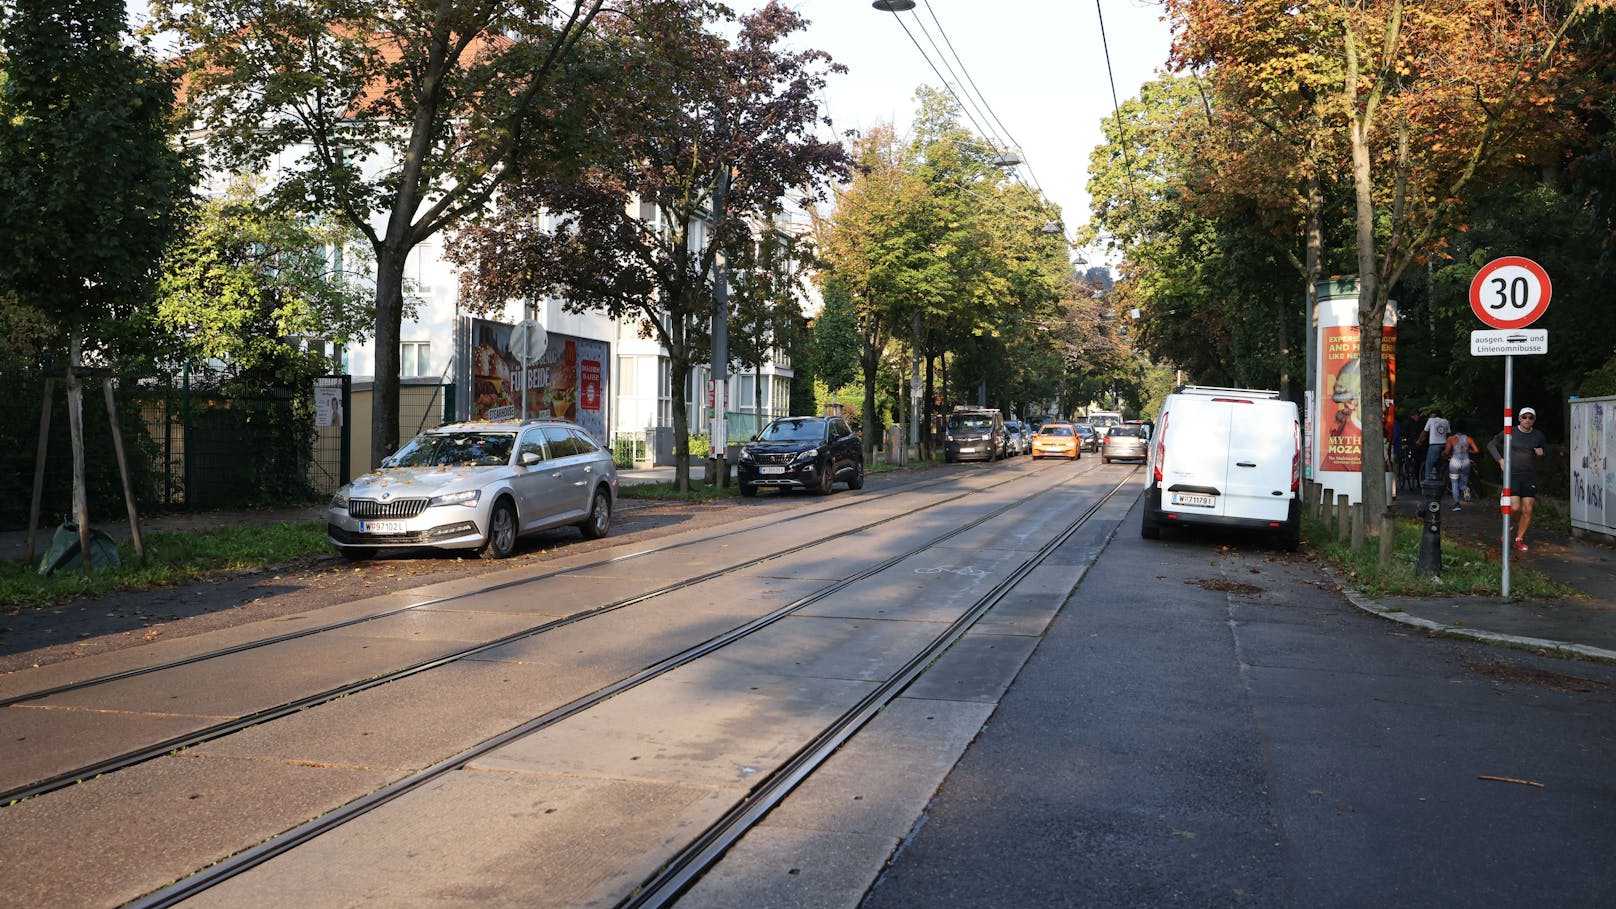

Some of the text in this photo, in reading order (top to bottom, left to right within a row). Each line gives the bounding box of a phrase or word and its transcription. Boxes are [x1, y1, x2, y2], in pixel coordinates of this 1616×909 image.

[1490, 277, 1528, 309] 30
[1477, 345, 1542, 353] Linienomnibusse
[527, 366, 550, 390] BEIDE
